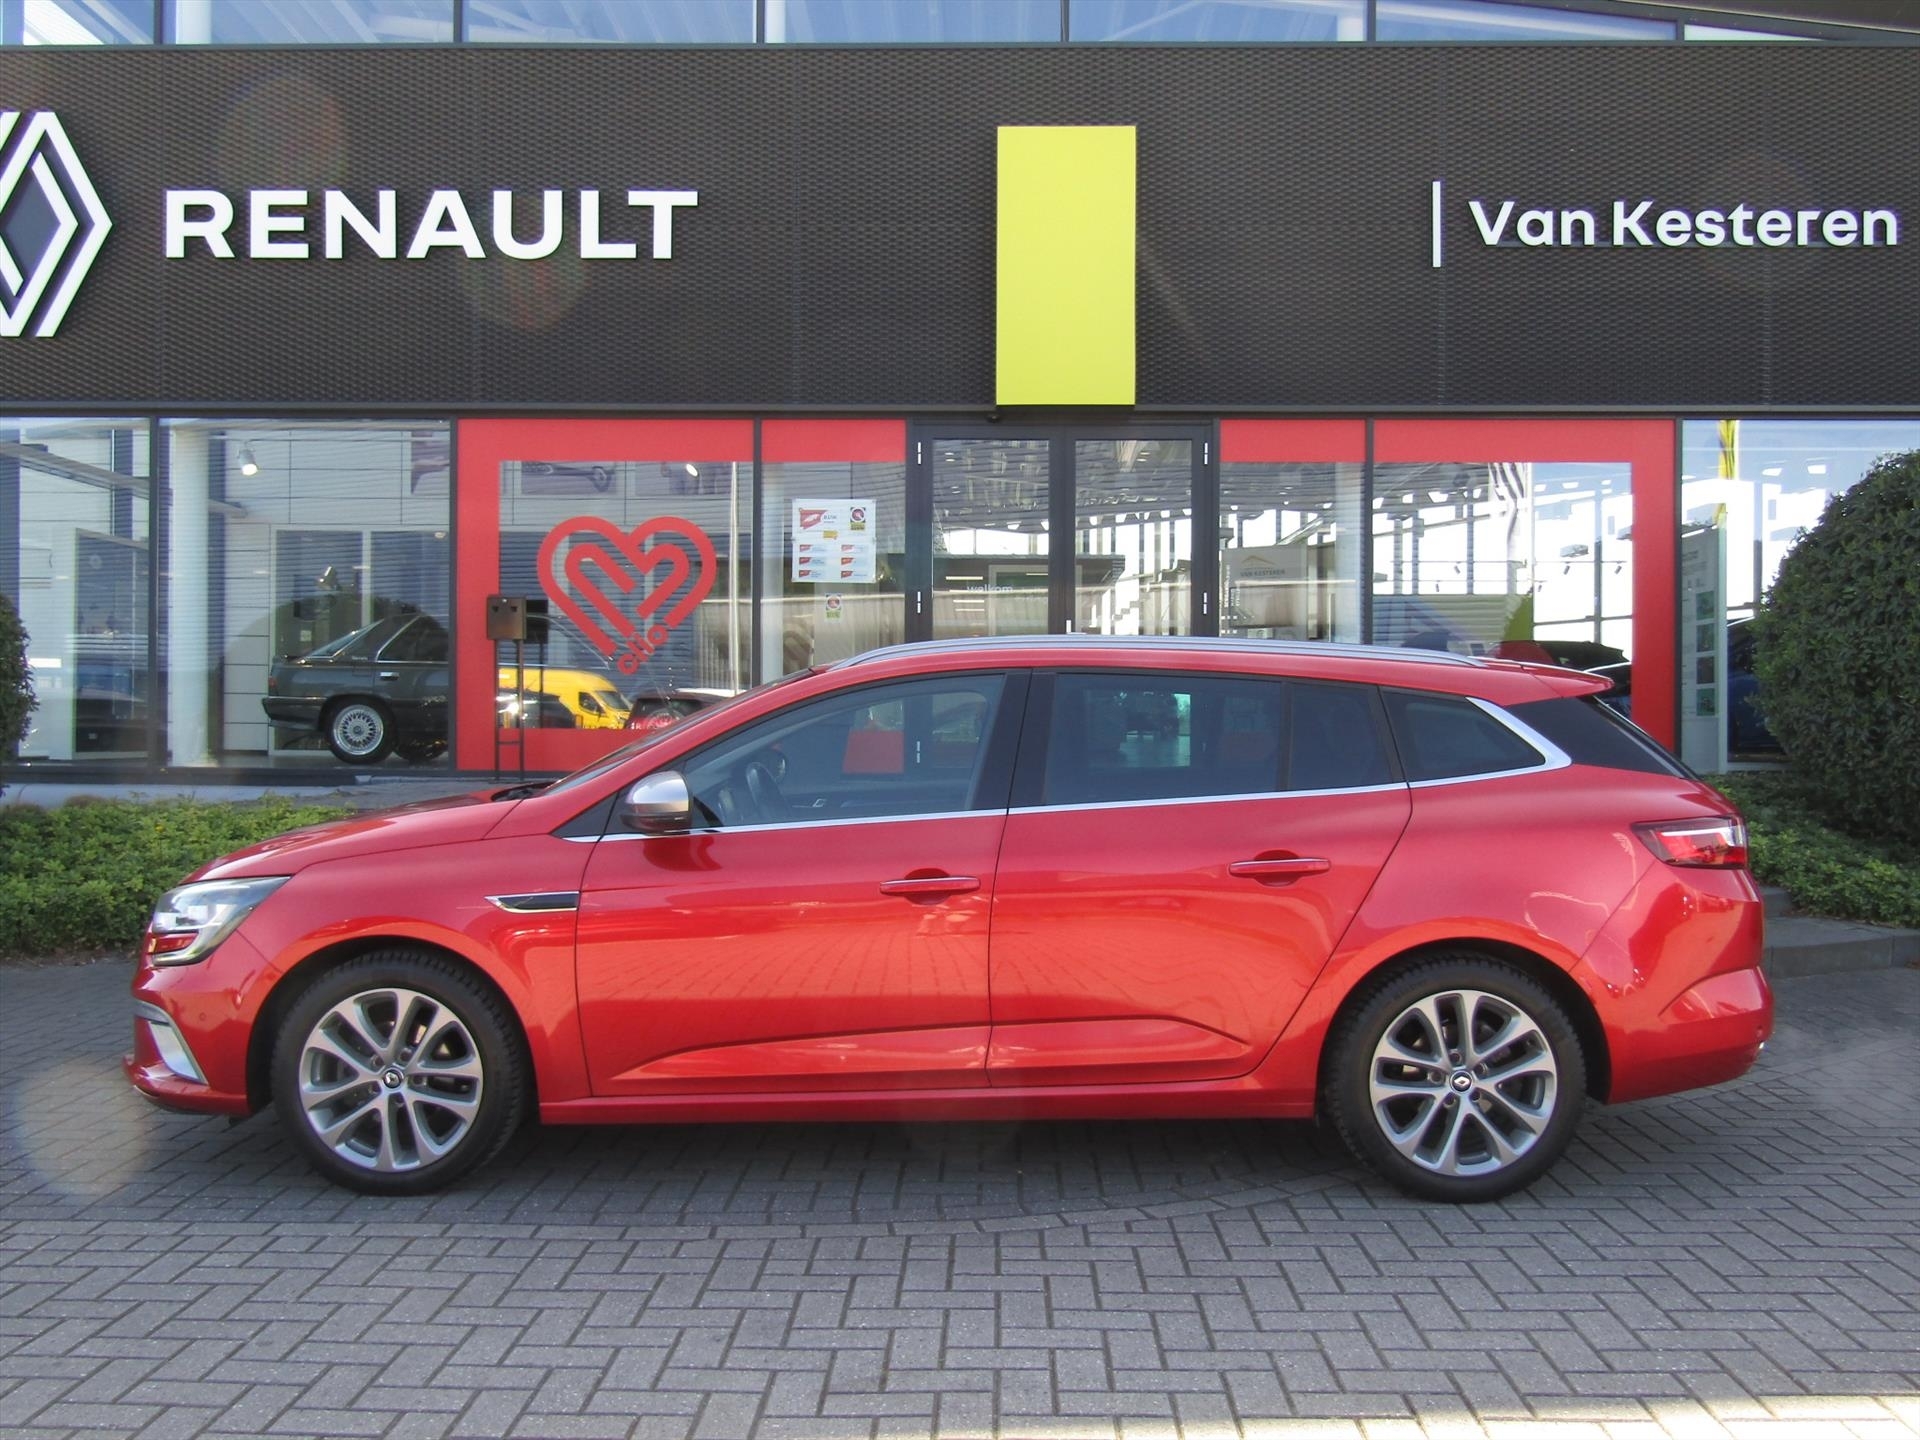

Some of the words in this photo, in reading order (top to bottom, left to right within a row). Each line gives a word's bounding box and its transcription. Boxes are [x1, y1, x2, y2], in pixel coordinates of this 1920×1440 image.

[165, 190, 699, 259] RENAULT
[1469, 201, 1596, 246] Van
[1614, 201, 1898, 247] Kesteren
[966, 584, 1014, 594] welkom
